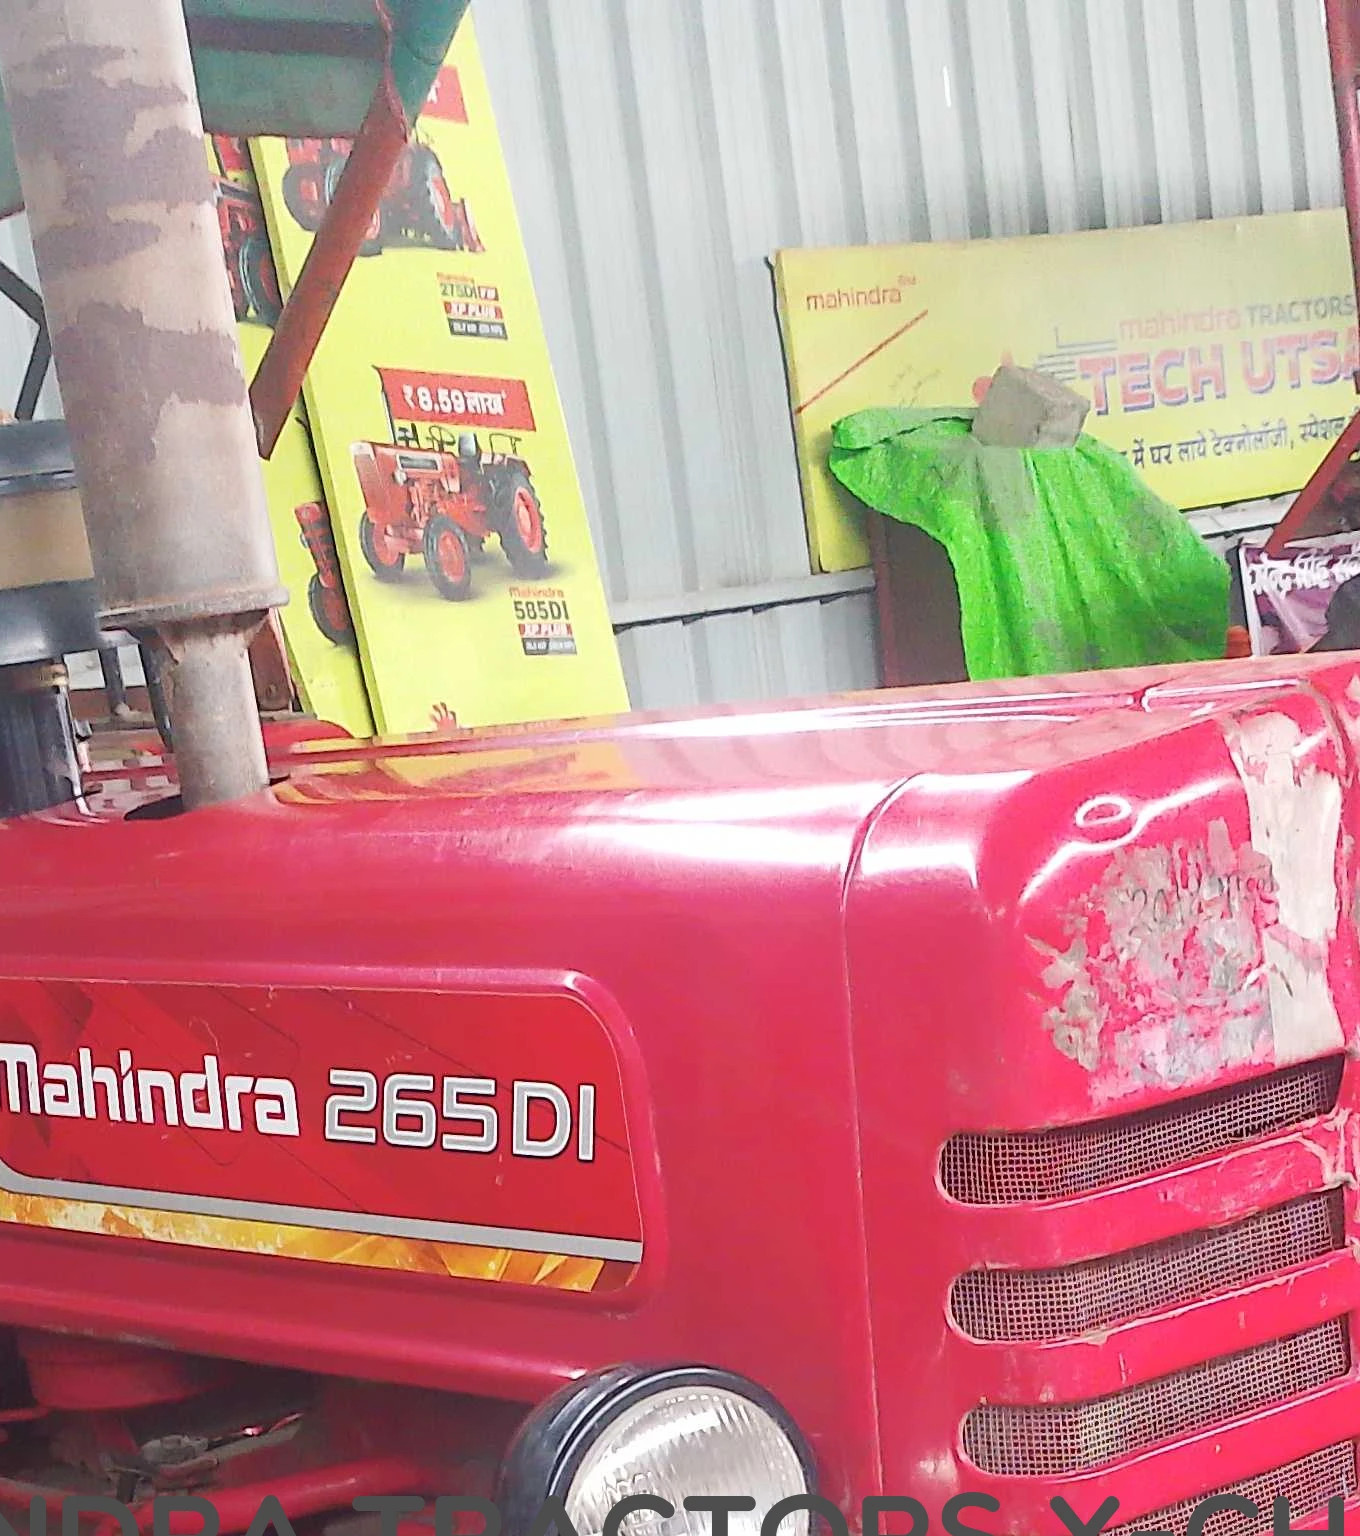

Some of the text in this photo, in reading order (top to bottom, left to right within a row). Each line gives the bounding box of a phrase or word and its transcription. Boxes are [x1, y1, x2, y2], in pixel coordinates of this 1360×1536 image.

[806, 286, 902, 312] mahindra
[1119, 295, 1356, 341] mahindra TRACTORS
[1075, 343, 1228, 416] TECH
[513, 599, 570, 621] 585DI
